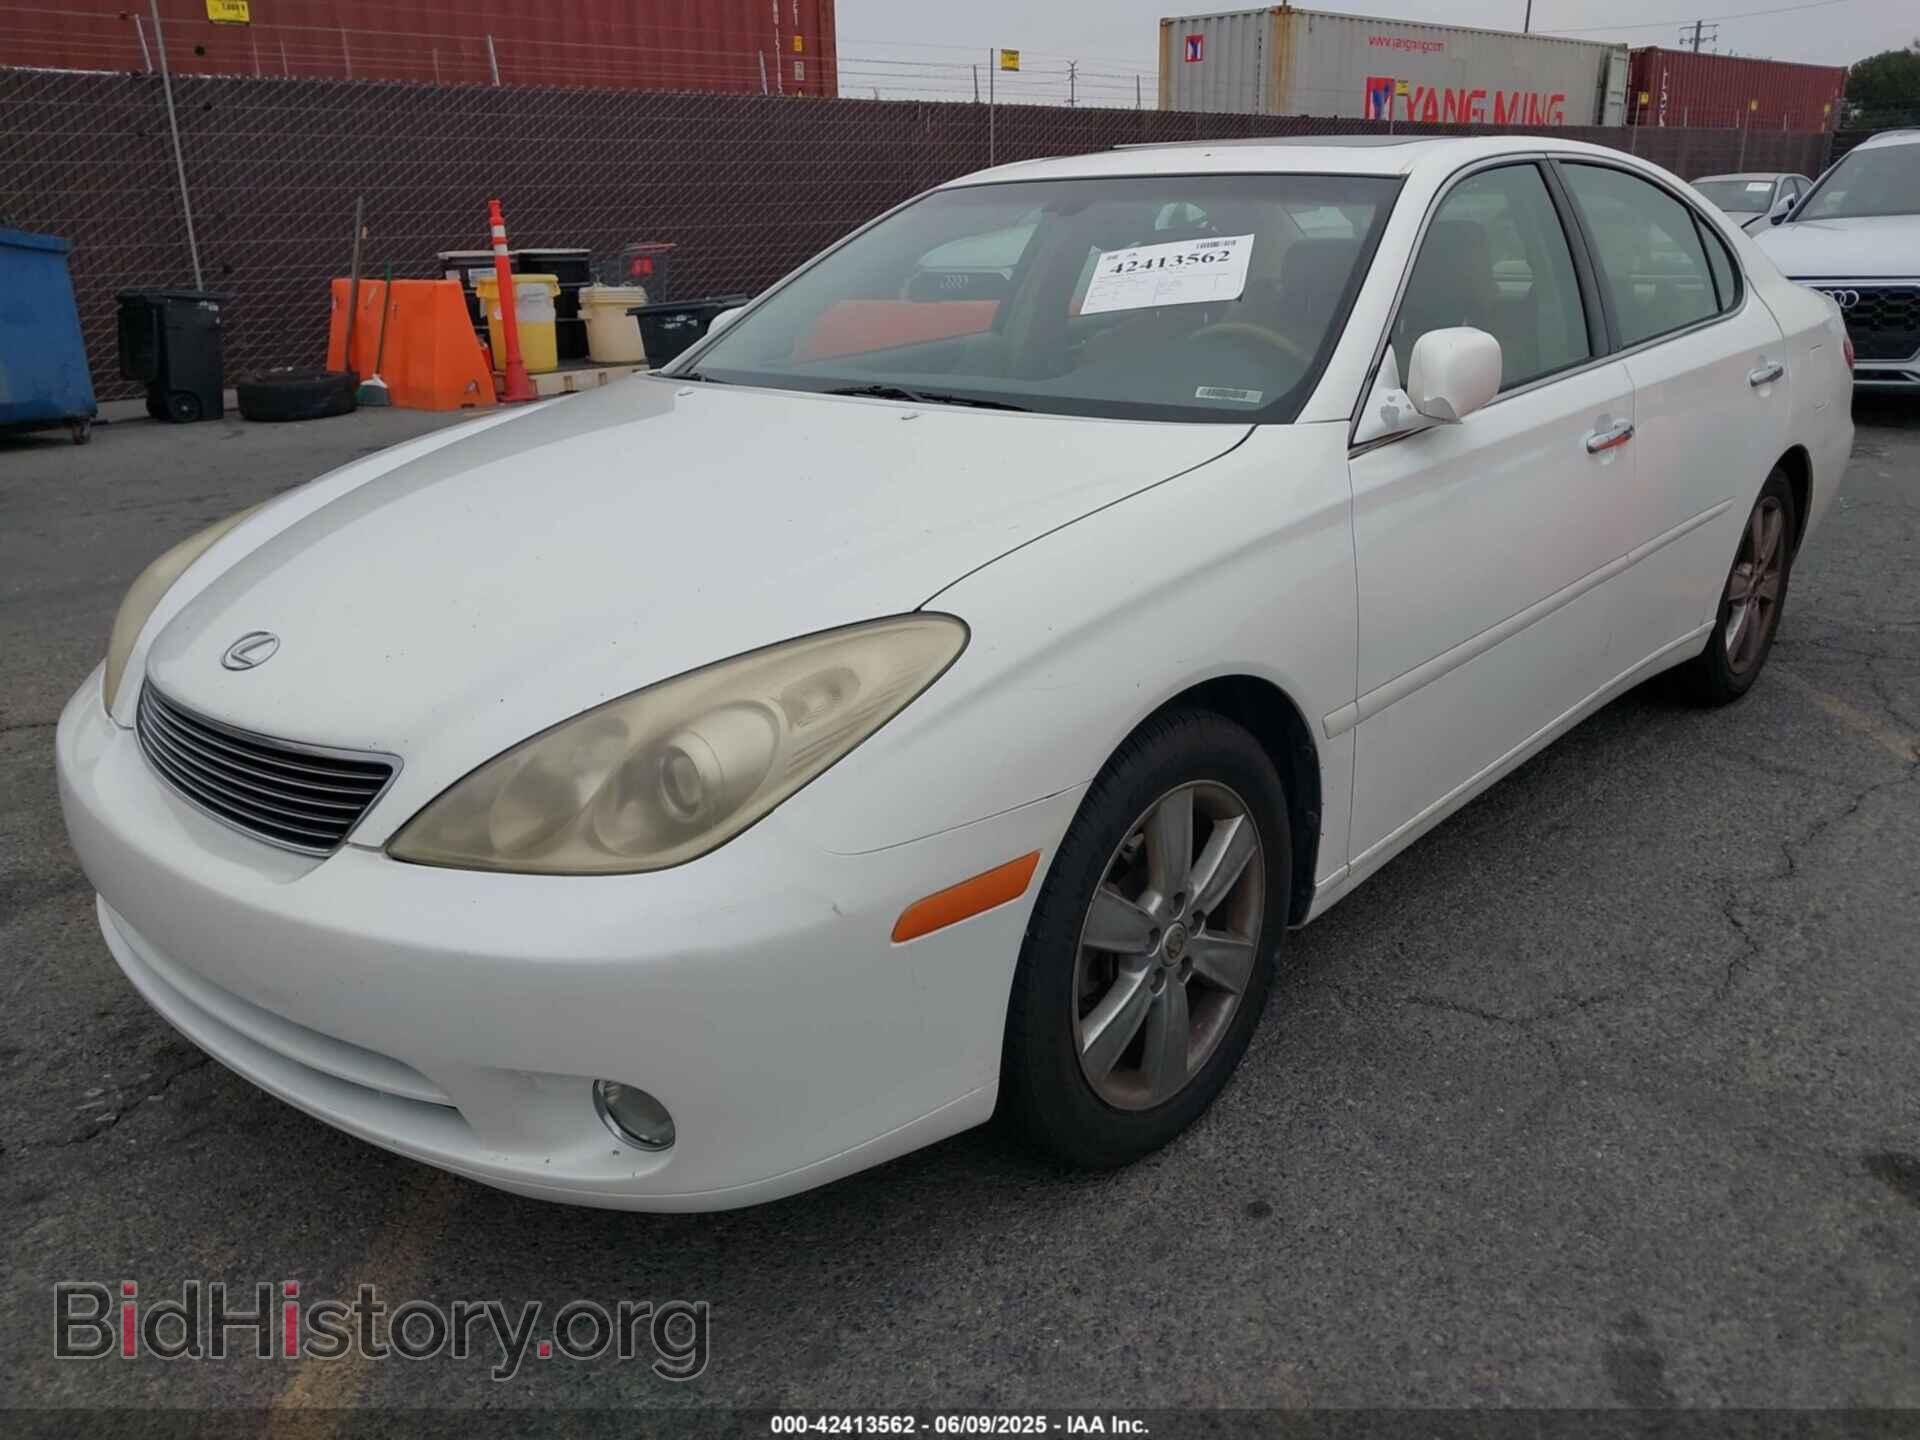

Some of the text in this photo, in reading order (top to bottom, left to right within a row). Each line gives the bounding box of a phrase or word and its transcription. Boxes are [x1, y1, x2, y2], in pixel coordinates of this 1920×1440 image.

[1406, 86, 1487, 123] YANG
[1492, 90, 1566, 126] MING
[1110, 250, 1231, 274] 42413562
